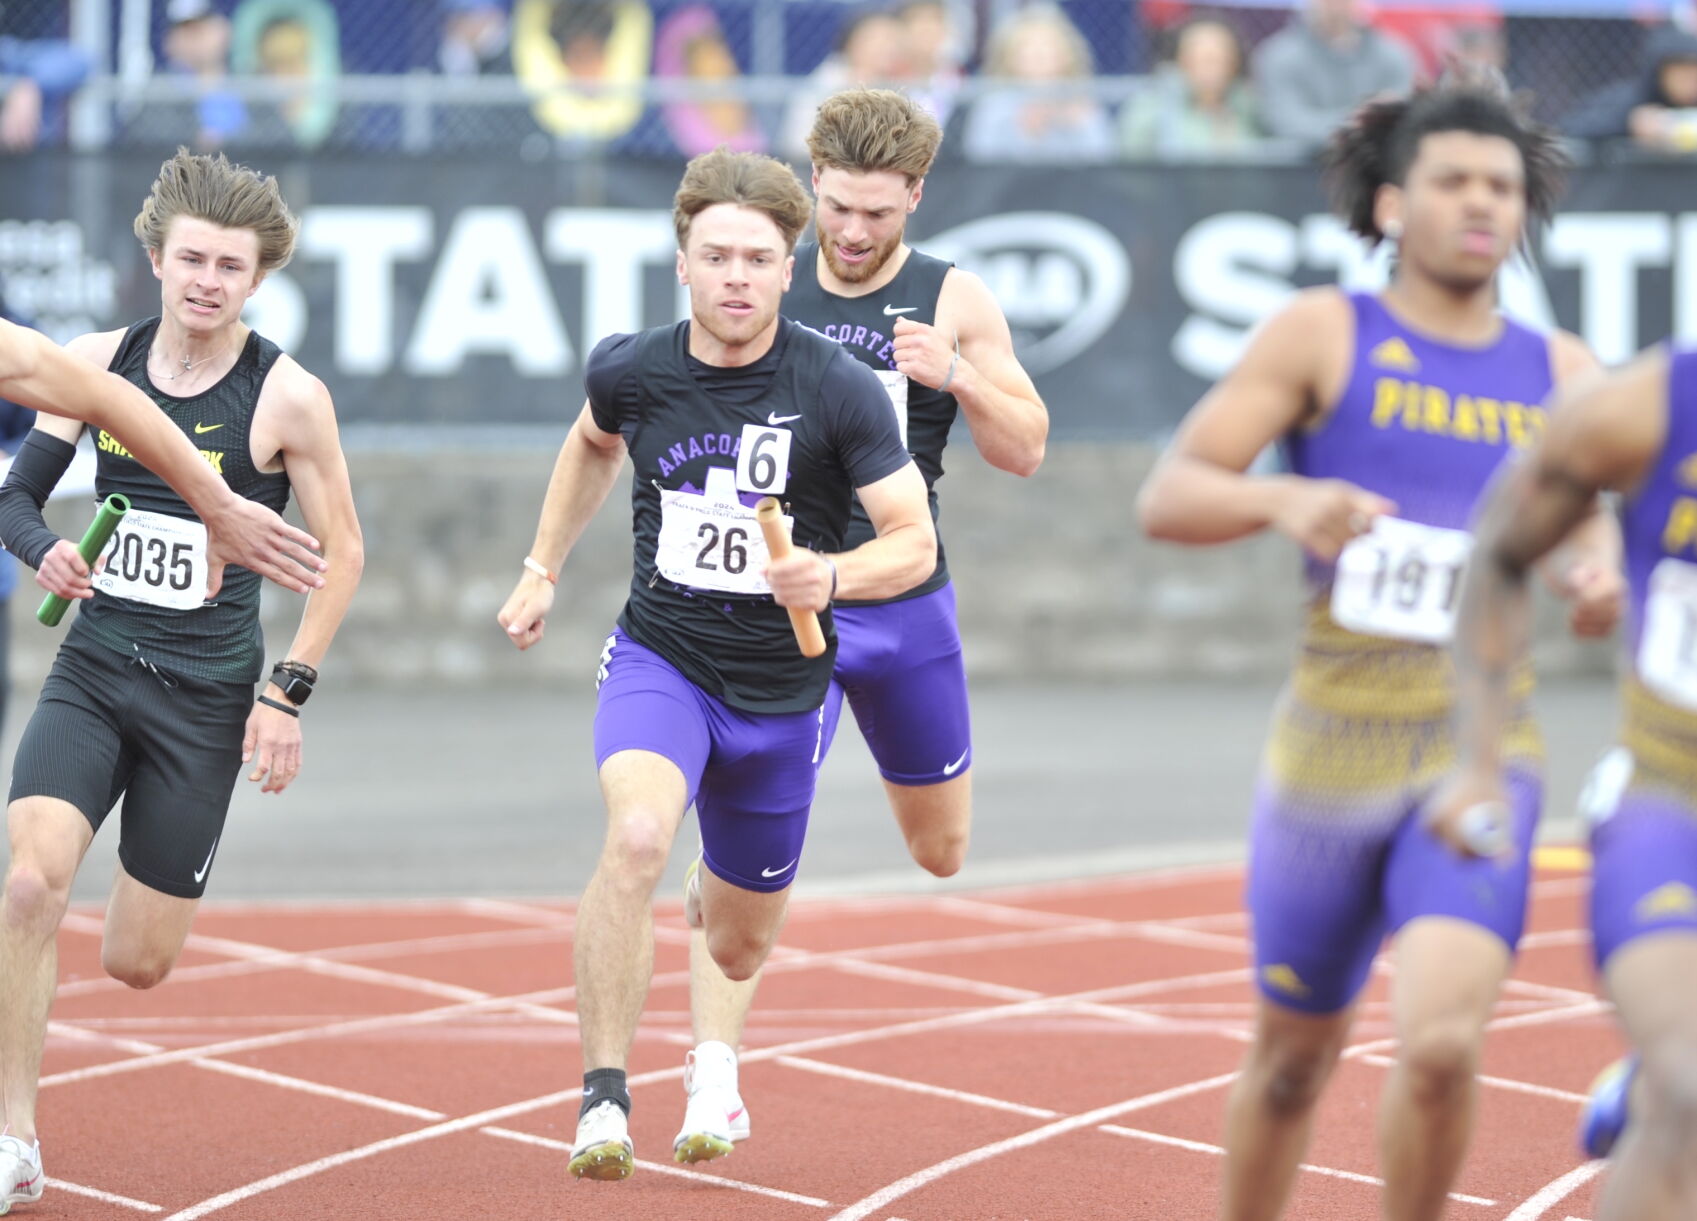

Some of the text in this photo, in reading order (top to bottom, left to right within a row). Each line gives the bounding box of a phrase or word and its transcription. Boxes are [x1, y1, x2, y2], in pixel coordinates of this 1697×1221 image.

[243, 204, 692, 378] TAT
[825, 324, 898, 371] CORTE
[748, 432, 778, 490] 6
[104, 530, 193, 591] 2035
[695, 522, 748, 574] 26
